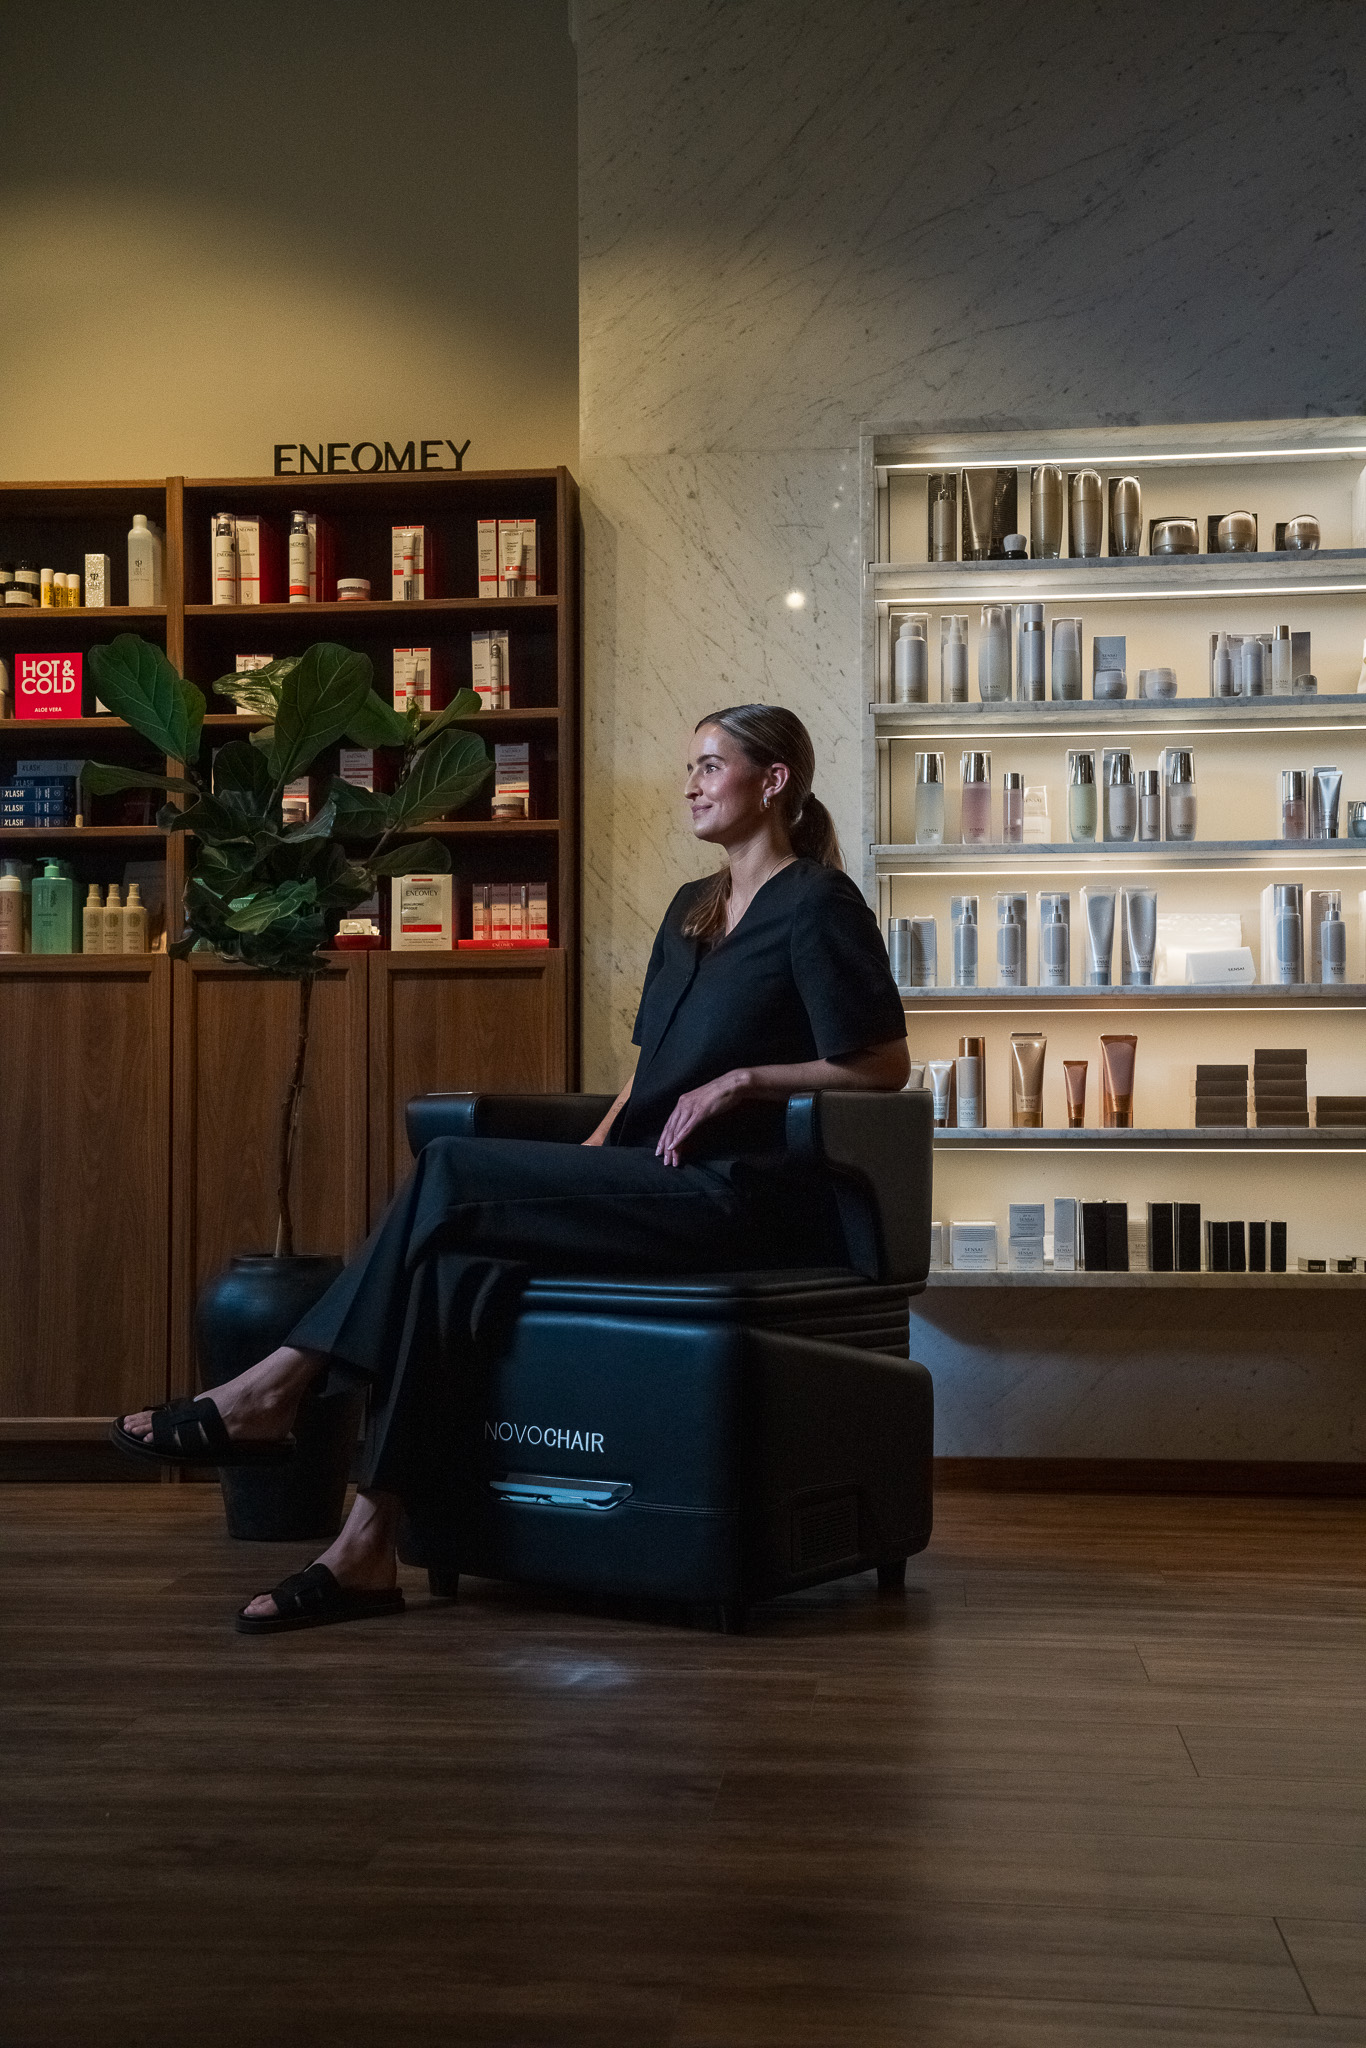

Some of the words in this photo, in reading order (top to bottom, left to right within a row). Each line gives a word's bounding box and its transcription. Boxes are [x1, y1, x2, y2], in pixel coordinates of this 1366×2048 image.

[273, 439, 471, 476] ENEOMEY
[21, 676, 76, 695] COLD
[4, 789, 25, 798] XLASH
[4, 804, 24, 812] XLASH
[4, 818, 24, 827] XLASH
[484, 1420, 605, 1454] NOVOCHAIR
